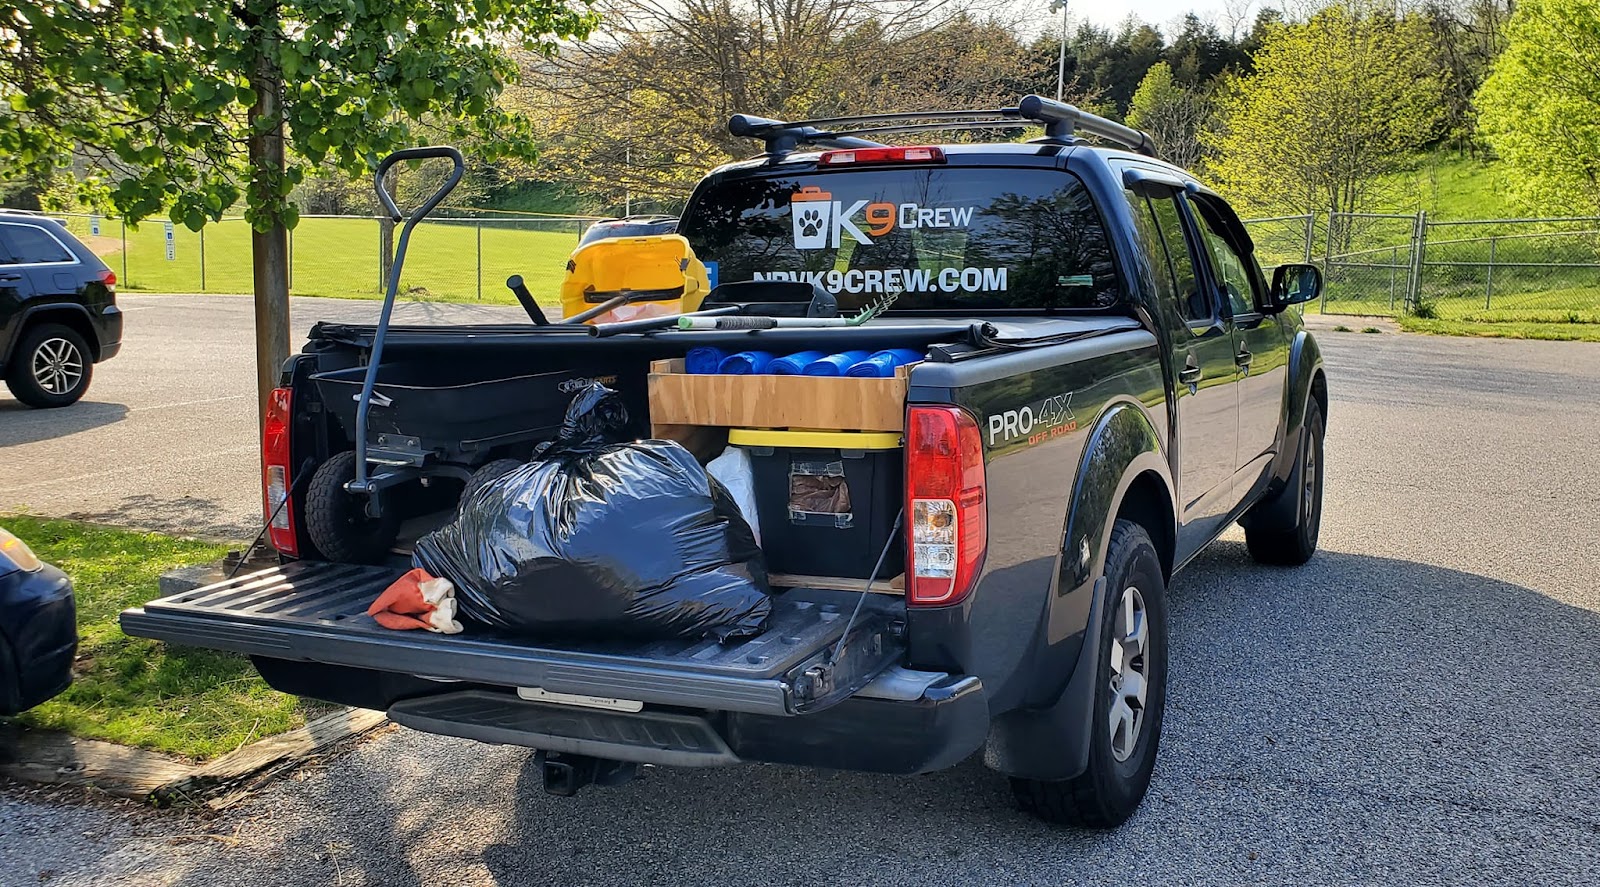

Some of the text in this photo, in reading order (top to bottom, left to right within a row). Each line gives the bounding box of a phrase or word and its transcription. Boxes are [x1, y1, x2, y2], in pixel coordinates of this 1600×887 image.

[831, 200, 896, 249] K9
[1028, 420, 1078, 445] OFF ROAD
